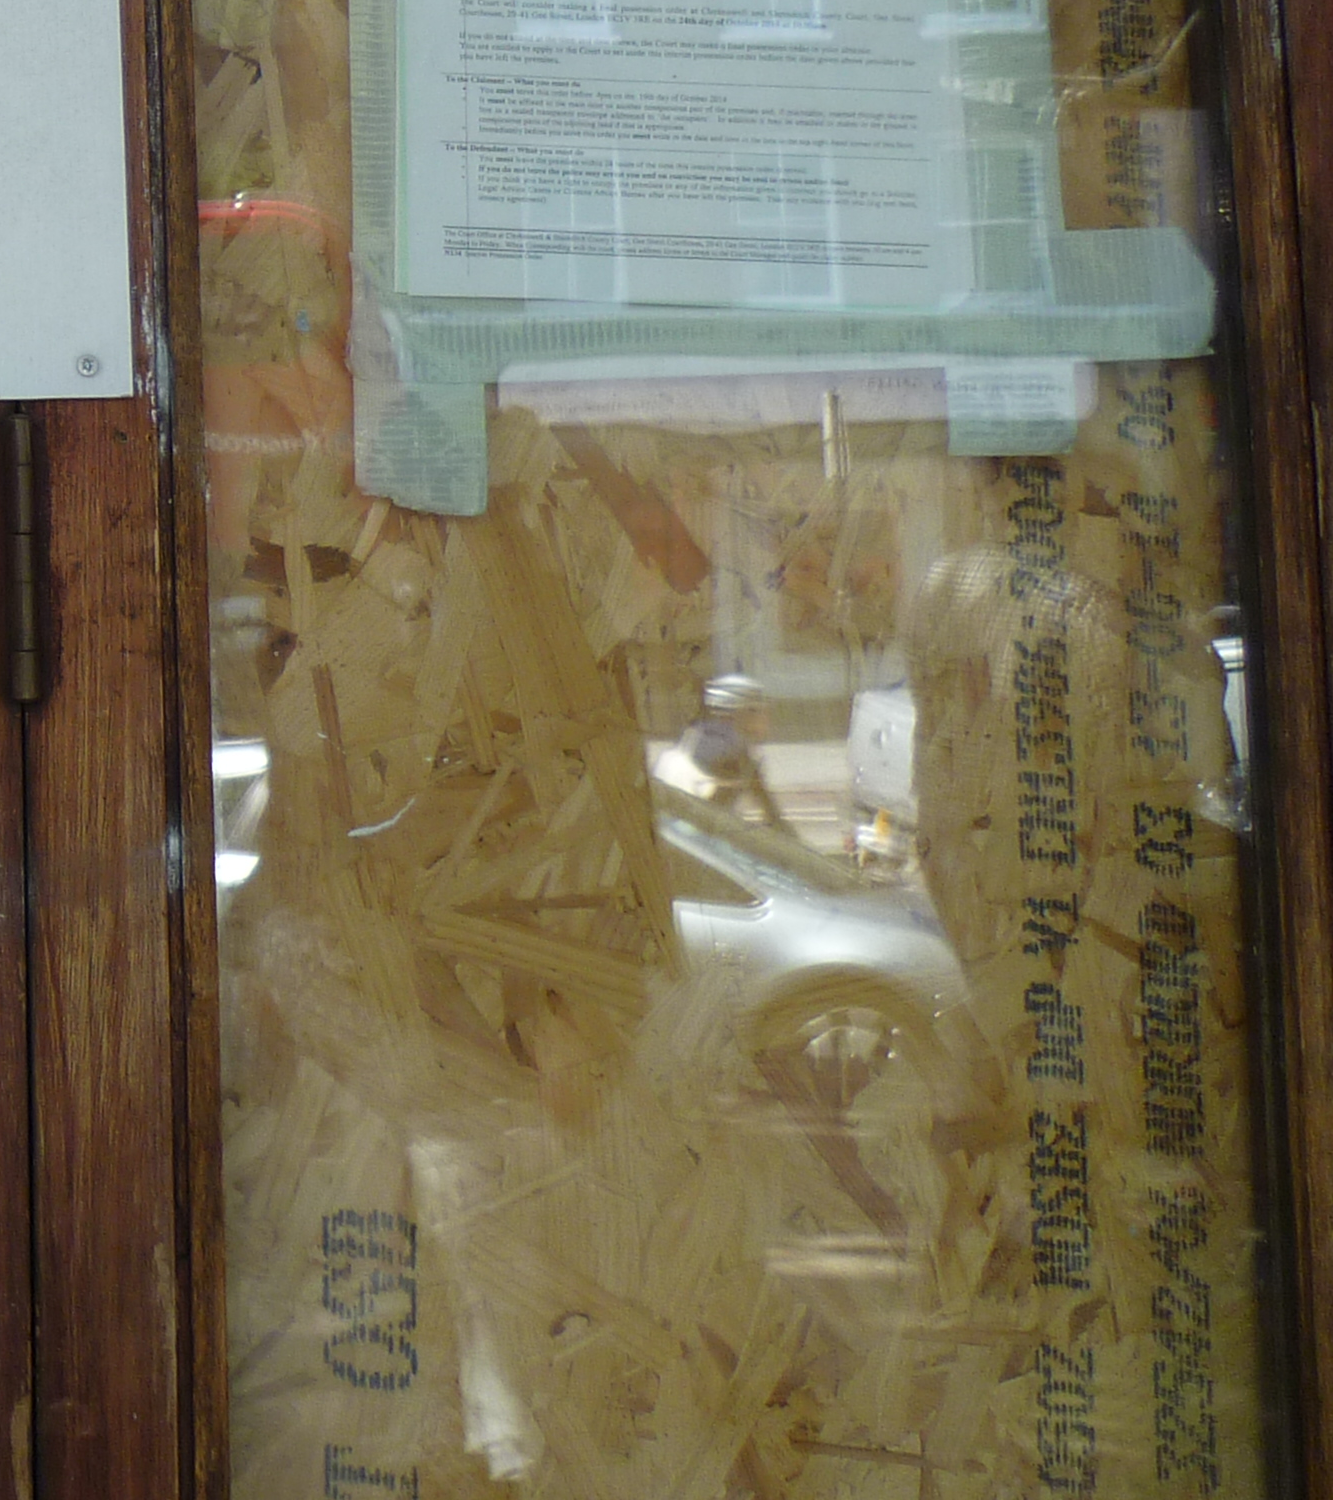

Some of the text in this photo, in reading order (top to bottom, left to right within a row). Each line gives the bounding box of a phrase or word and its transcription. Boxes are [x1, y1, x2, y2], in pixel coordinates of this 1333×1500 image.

[1133, 800, 1194, 877] 03
[1137, 900, 1204, 1158] NORBORD
[321, 1208, 419, 1394] OSB
